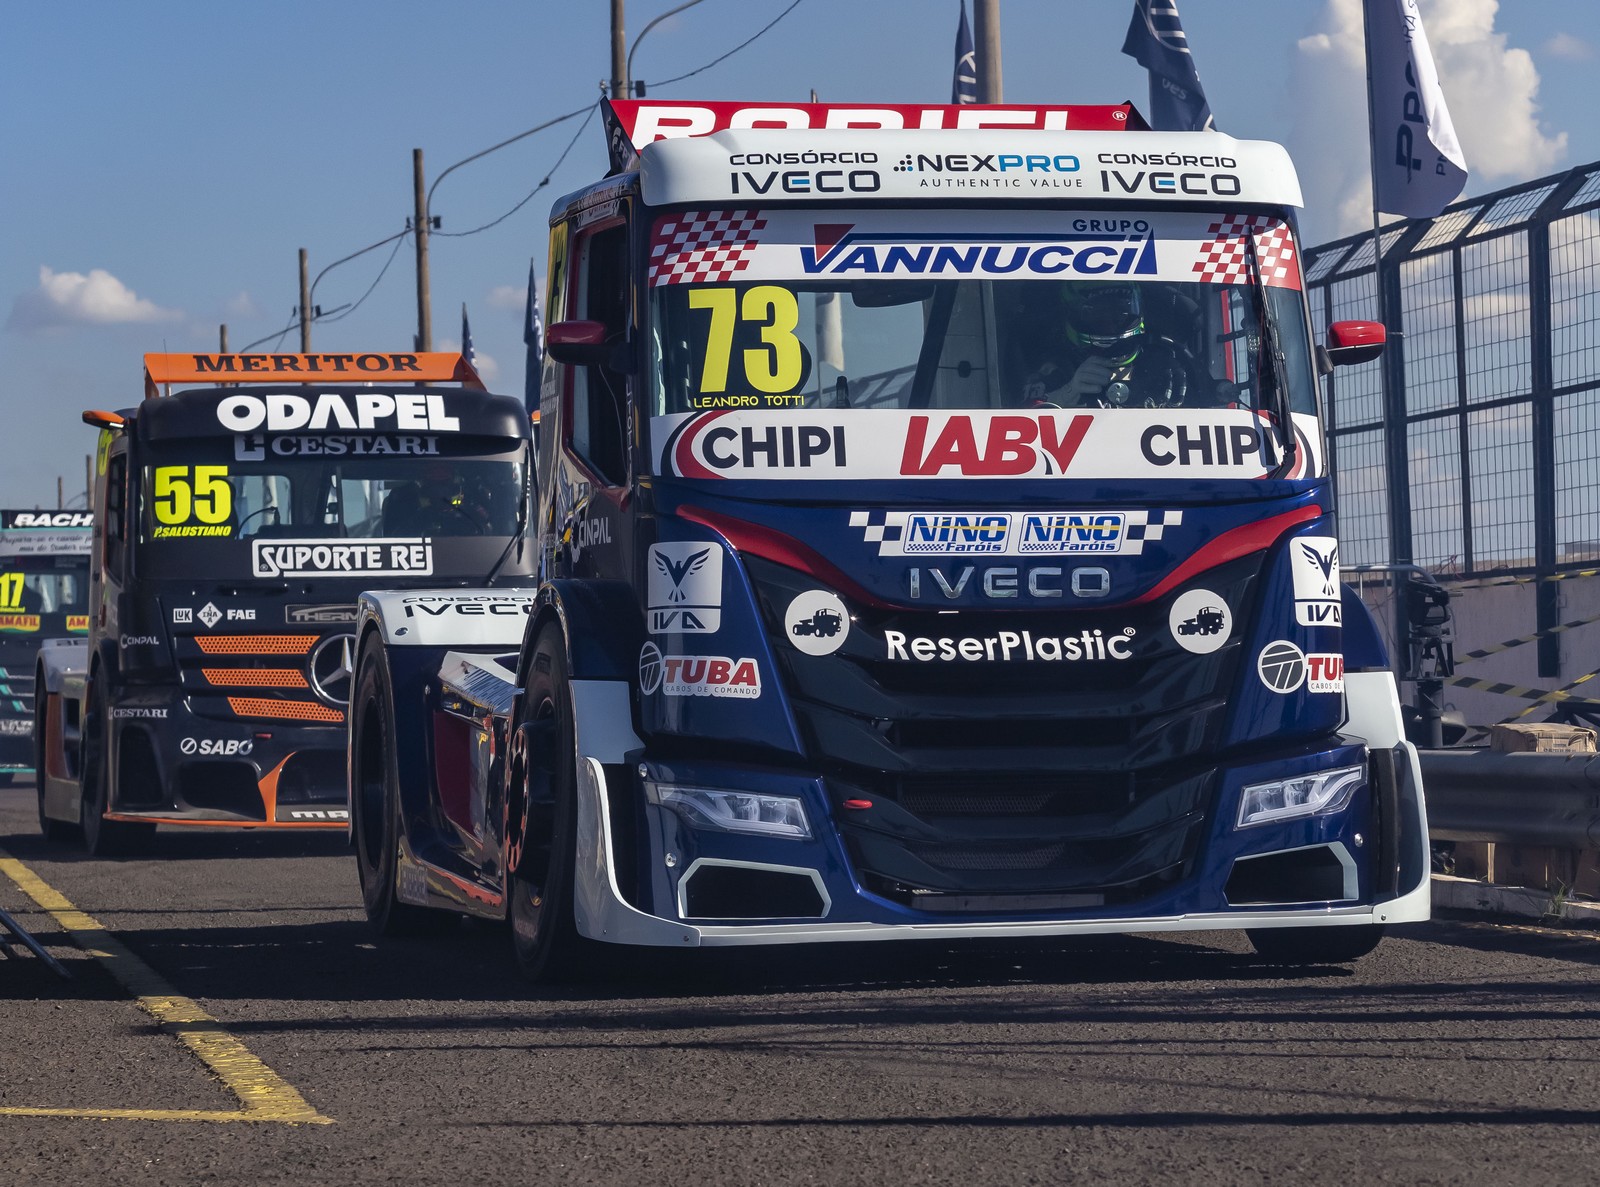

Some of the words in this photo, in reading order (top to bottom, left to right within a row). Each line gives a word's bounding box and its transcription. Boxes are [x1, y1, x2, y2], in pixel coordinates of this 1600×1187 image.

[730, 150, 878, 165] CONSÓRCIO
[918, 154, 1080, 173] NEXPRO
[1098, 152, 1236, 168] CONSÓRCIO
[731, 170, 881, 194] IVECO
[920, 178, 1021, 188] AUTHENTIC
[1031, 178, 1083, 188] VALUE
[1100, 170, 1241, 195] IVECO
[1072, 219, 1149, 232] GRUPO
[688, 285, 803, 393] 73
[193, 355, 422, 372] MERITOR
[694, 396, 758, 408] LEANDRO
[764, 395, 805, 406] TOTTI
[217, 394, 460, 431] ODAPEL
[271, 436, 440, 455] CESTARI
[702, 425, 847, 469] CHIPI
[154, 465, 232, 525] 55
[945, 541, 1002, 552] Faróis
[1060, 540, 1116, 551] Faróis
[258, 544, 383, 574] SUPORTE
[909, 566, 1111, 599] IVECO
[402, 596, 535, 604] CONSÓRCI
[227, 609, 256, 620] FAG
[665, 659, 757, 686] TUBA
[665, 685, 693, 693] CABOS
[697, 685, 708, 693] DE
[714, 686, 757, 695] COMANDO
[113, 708, 168, 718] CESTARI
